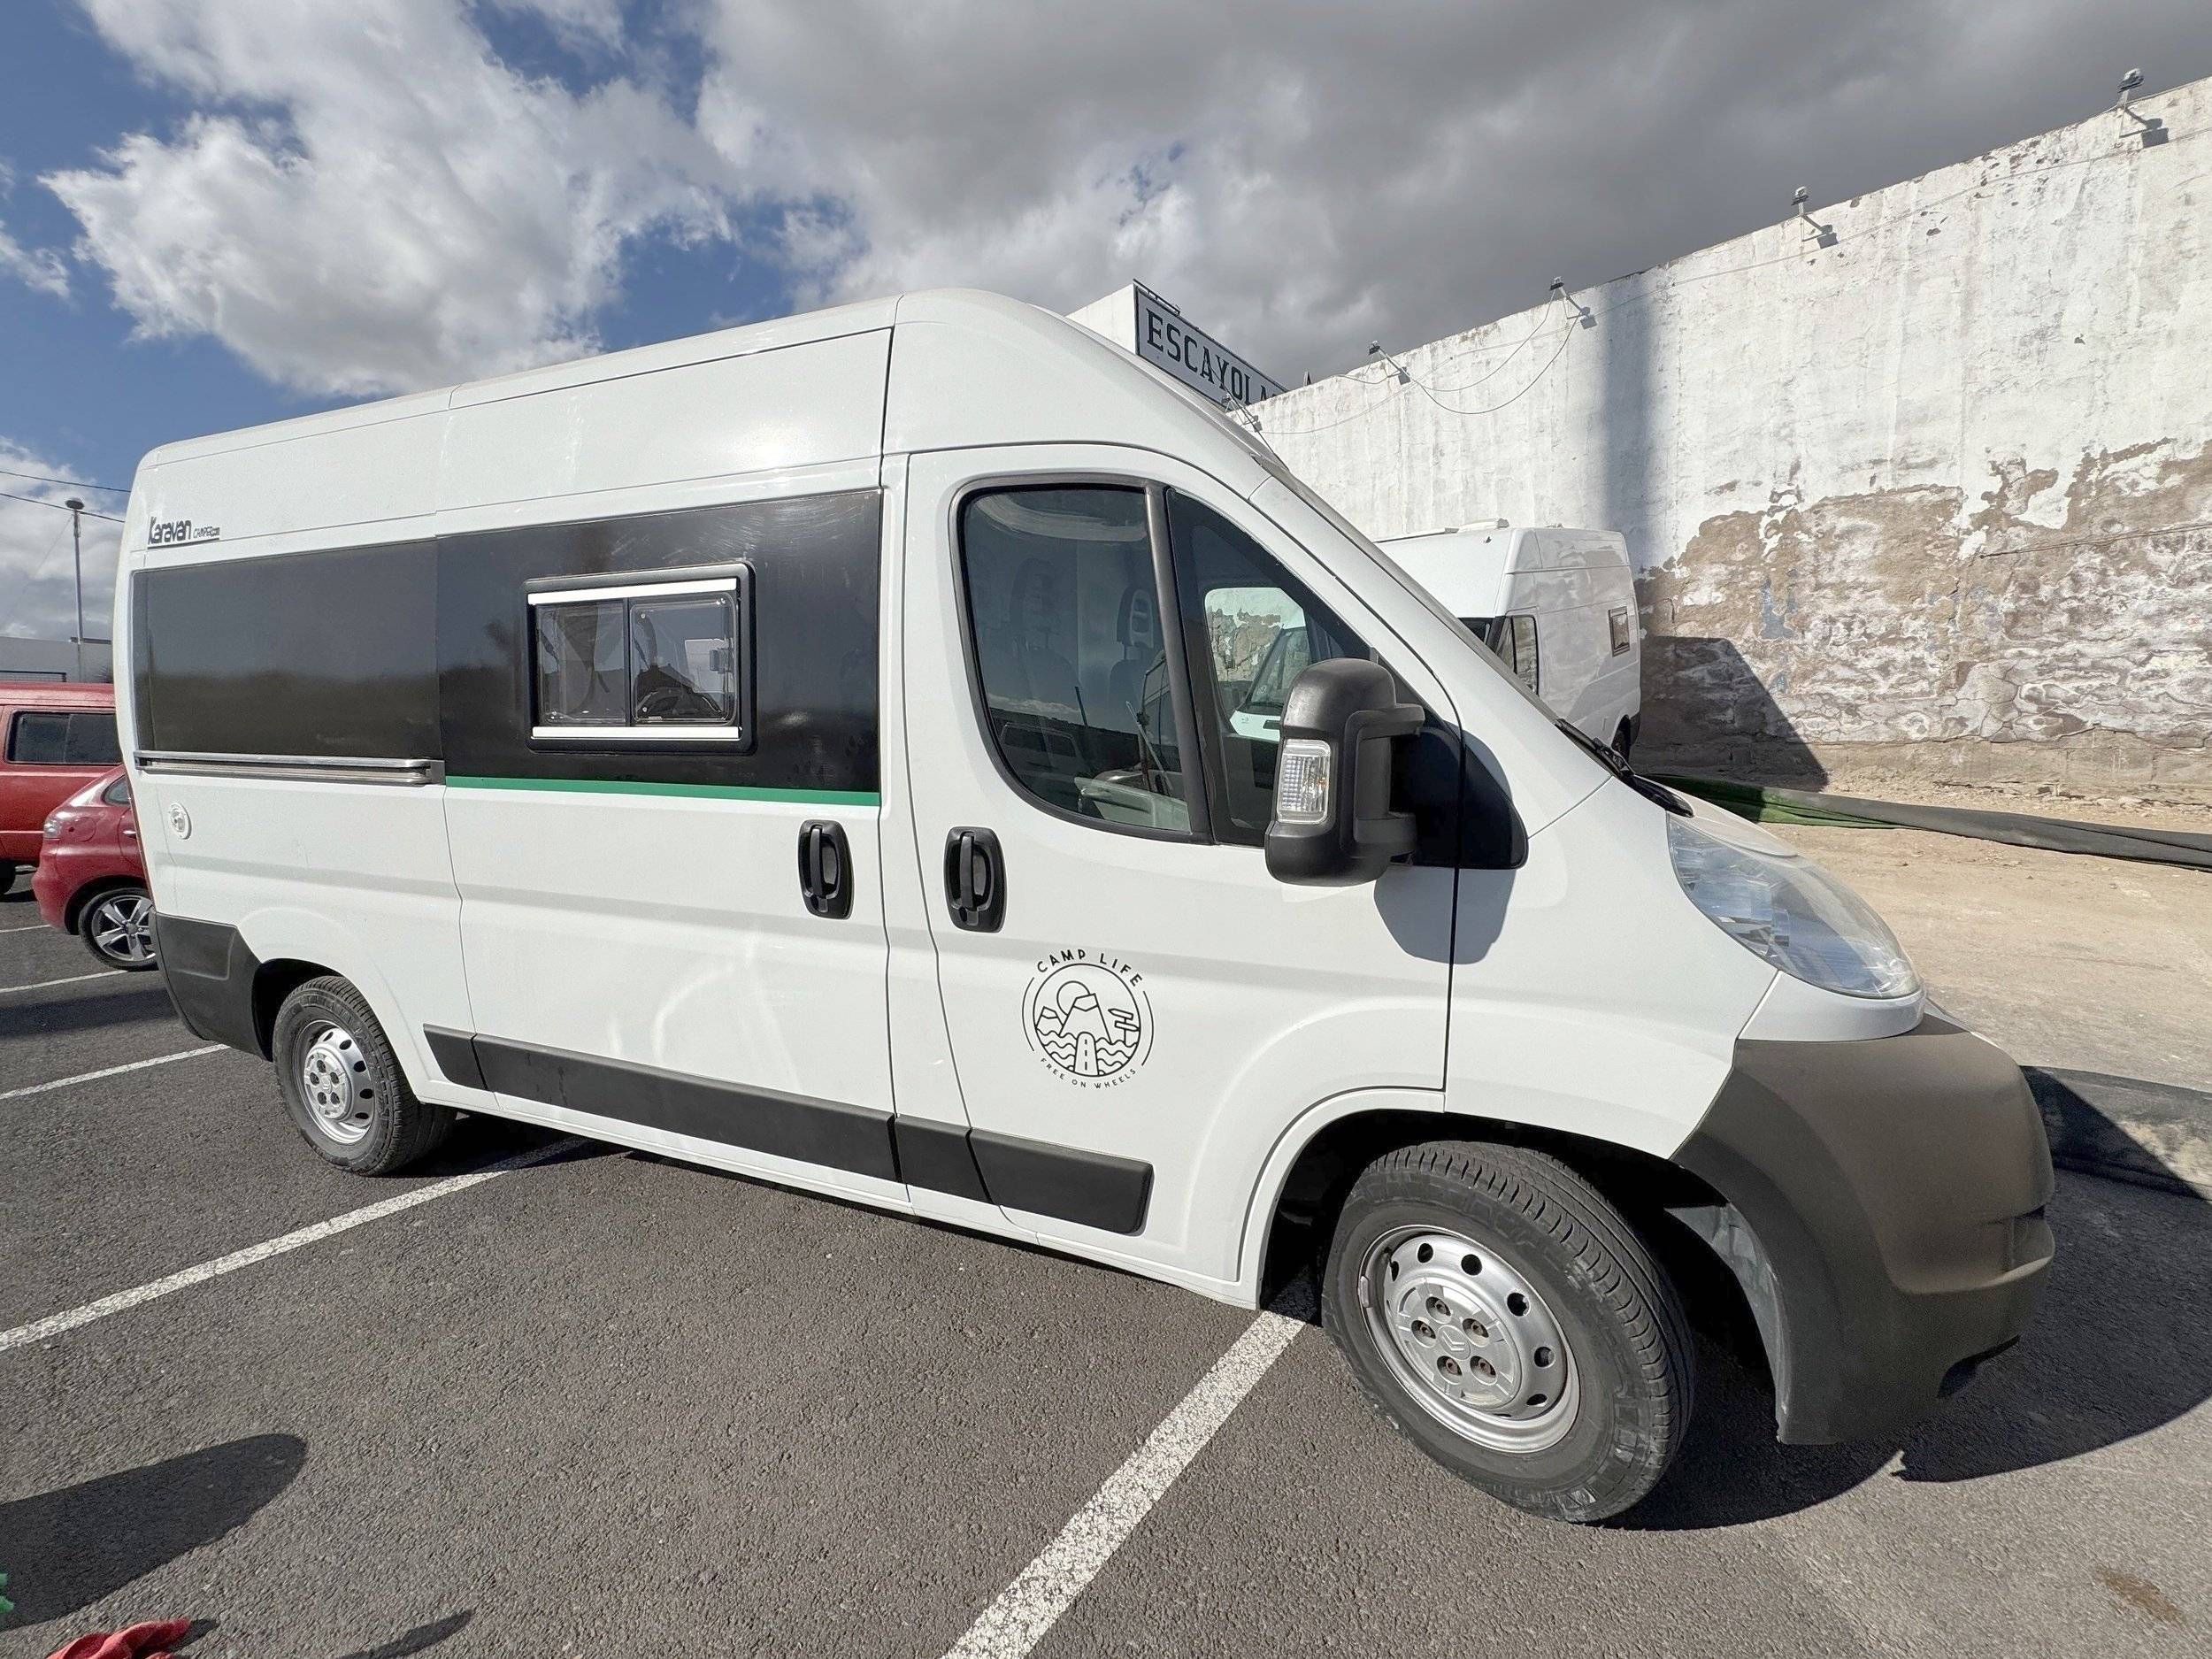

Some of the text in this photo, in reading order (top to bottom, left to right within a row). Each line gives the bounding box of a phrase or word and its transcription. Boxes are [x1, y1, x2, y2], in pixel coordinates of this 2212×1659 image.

[1146, 308, 1277, 405] ESCAYOL
[1037, 949, 1142, 987] CAMP LIFE
[1041, 1057, 1136, 1089] FREE ON WHEELS
